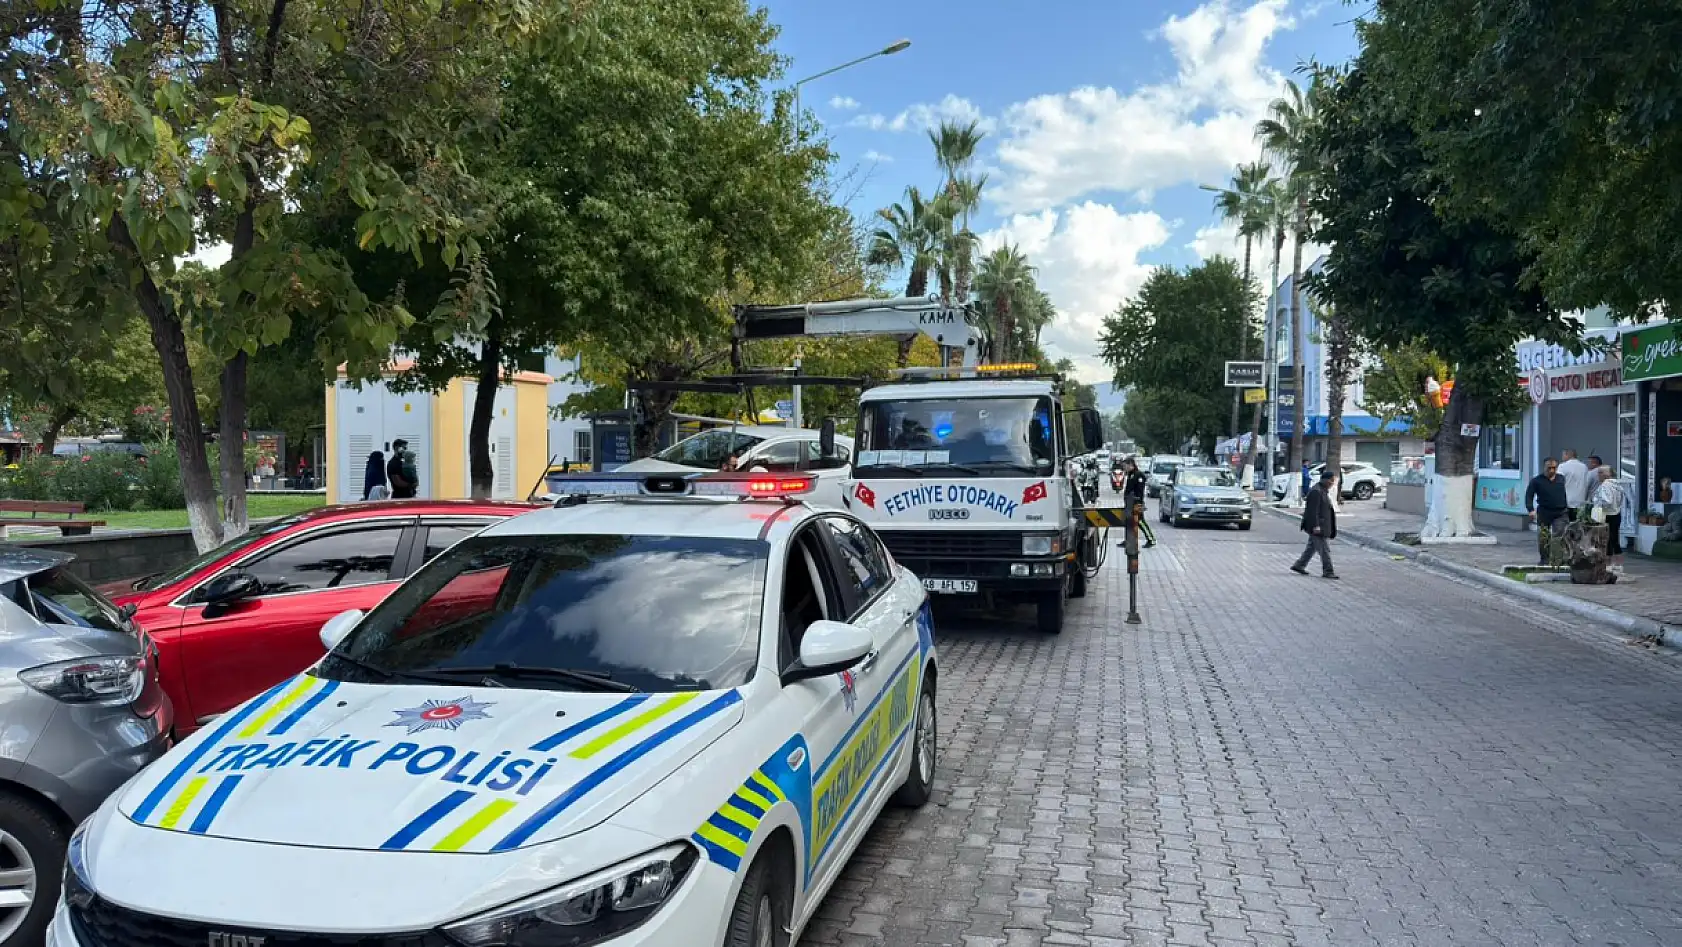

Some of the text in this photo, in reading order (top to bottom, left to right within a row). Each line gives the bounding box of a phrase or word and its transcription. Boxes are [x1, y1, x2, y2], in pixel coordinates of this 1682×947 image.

[920, 311, 954, 324] KAMA
[1551, 374, 1581, 393] FOTO
[884, 483, 1018, 519] FETHİYE OTOPARK
[928, 508, 970, 520] IVECO
[960, 580, 976, 591] 157
[197, 734, 558, 796] TRAFİK POLİSİ
[815, 756, 852, 839] TRAFİK
